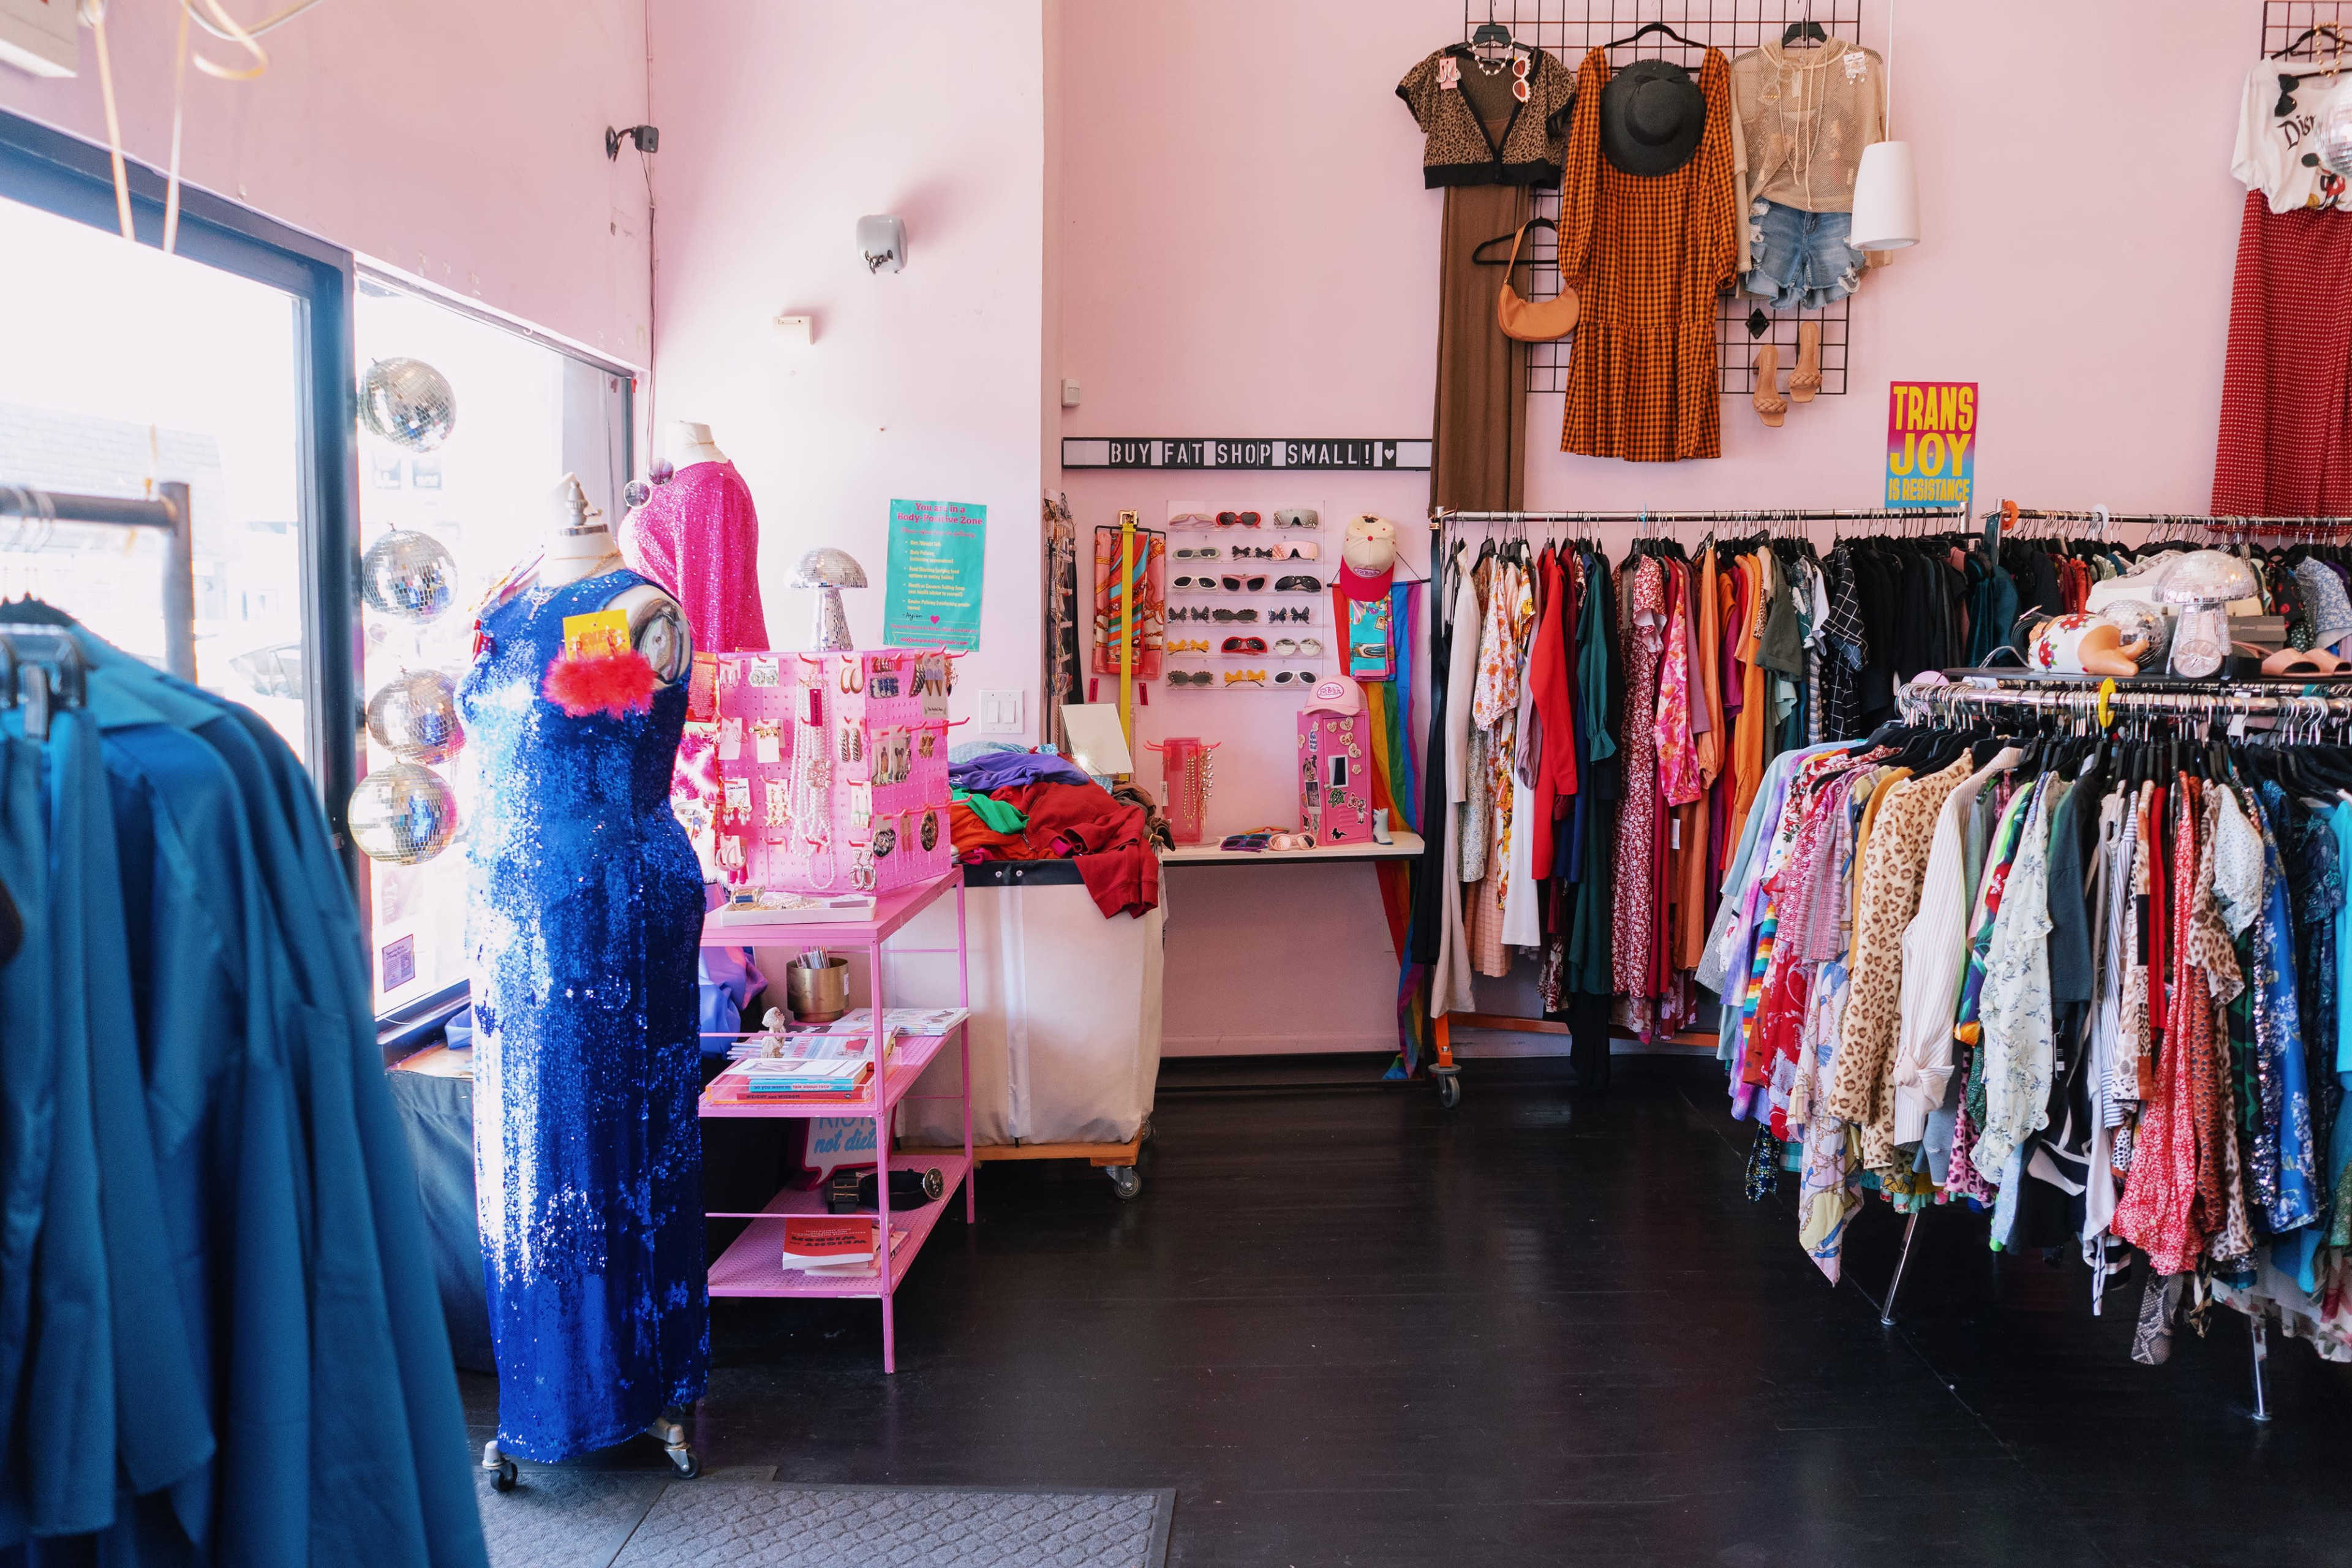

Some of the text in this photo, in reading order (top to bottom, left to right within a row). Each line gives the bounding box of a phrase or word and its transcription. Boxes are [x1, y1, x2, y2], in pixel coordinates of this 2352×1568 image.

[1893, 386, 1974, 431] TRANS
[1111, 443, 1370, 464] BUY FAT SHOP SMALL!
[1890, 432, 1972, 477] JOY
[1888, 478, 1970, 502] IS RESISTANCE
[915, 502, 932, 511] You
[897, 513, 983, 525] Body-Positive Zone
[813, 1129, 842, 1154] not
